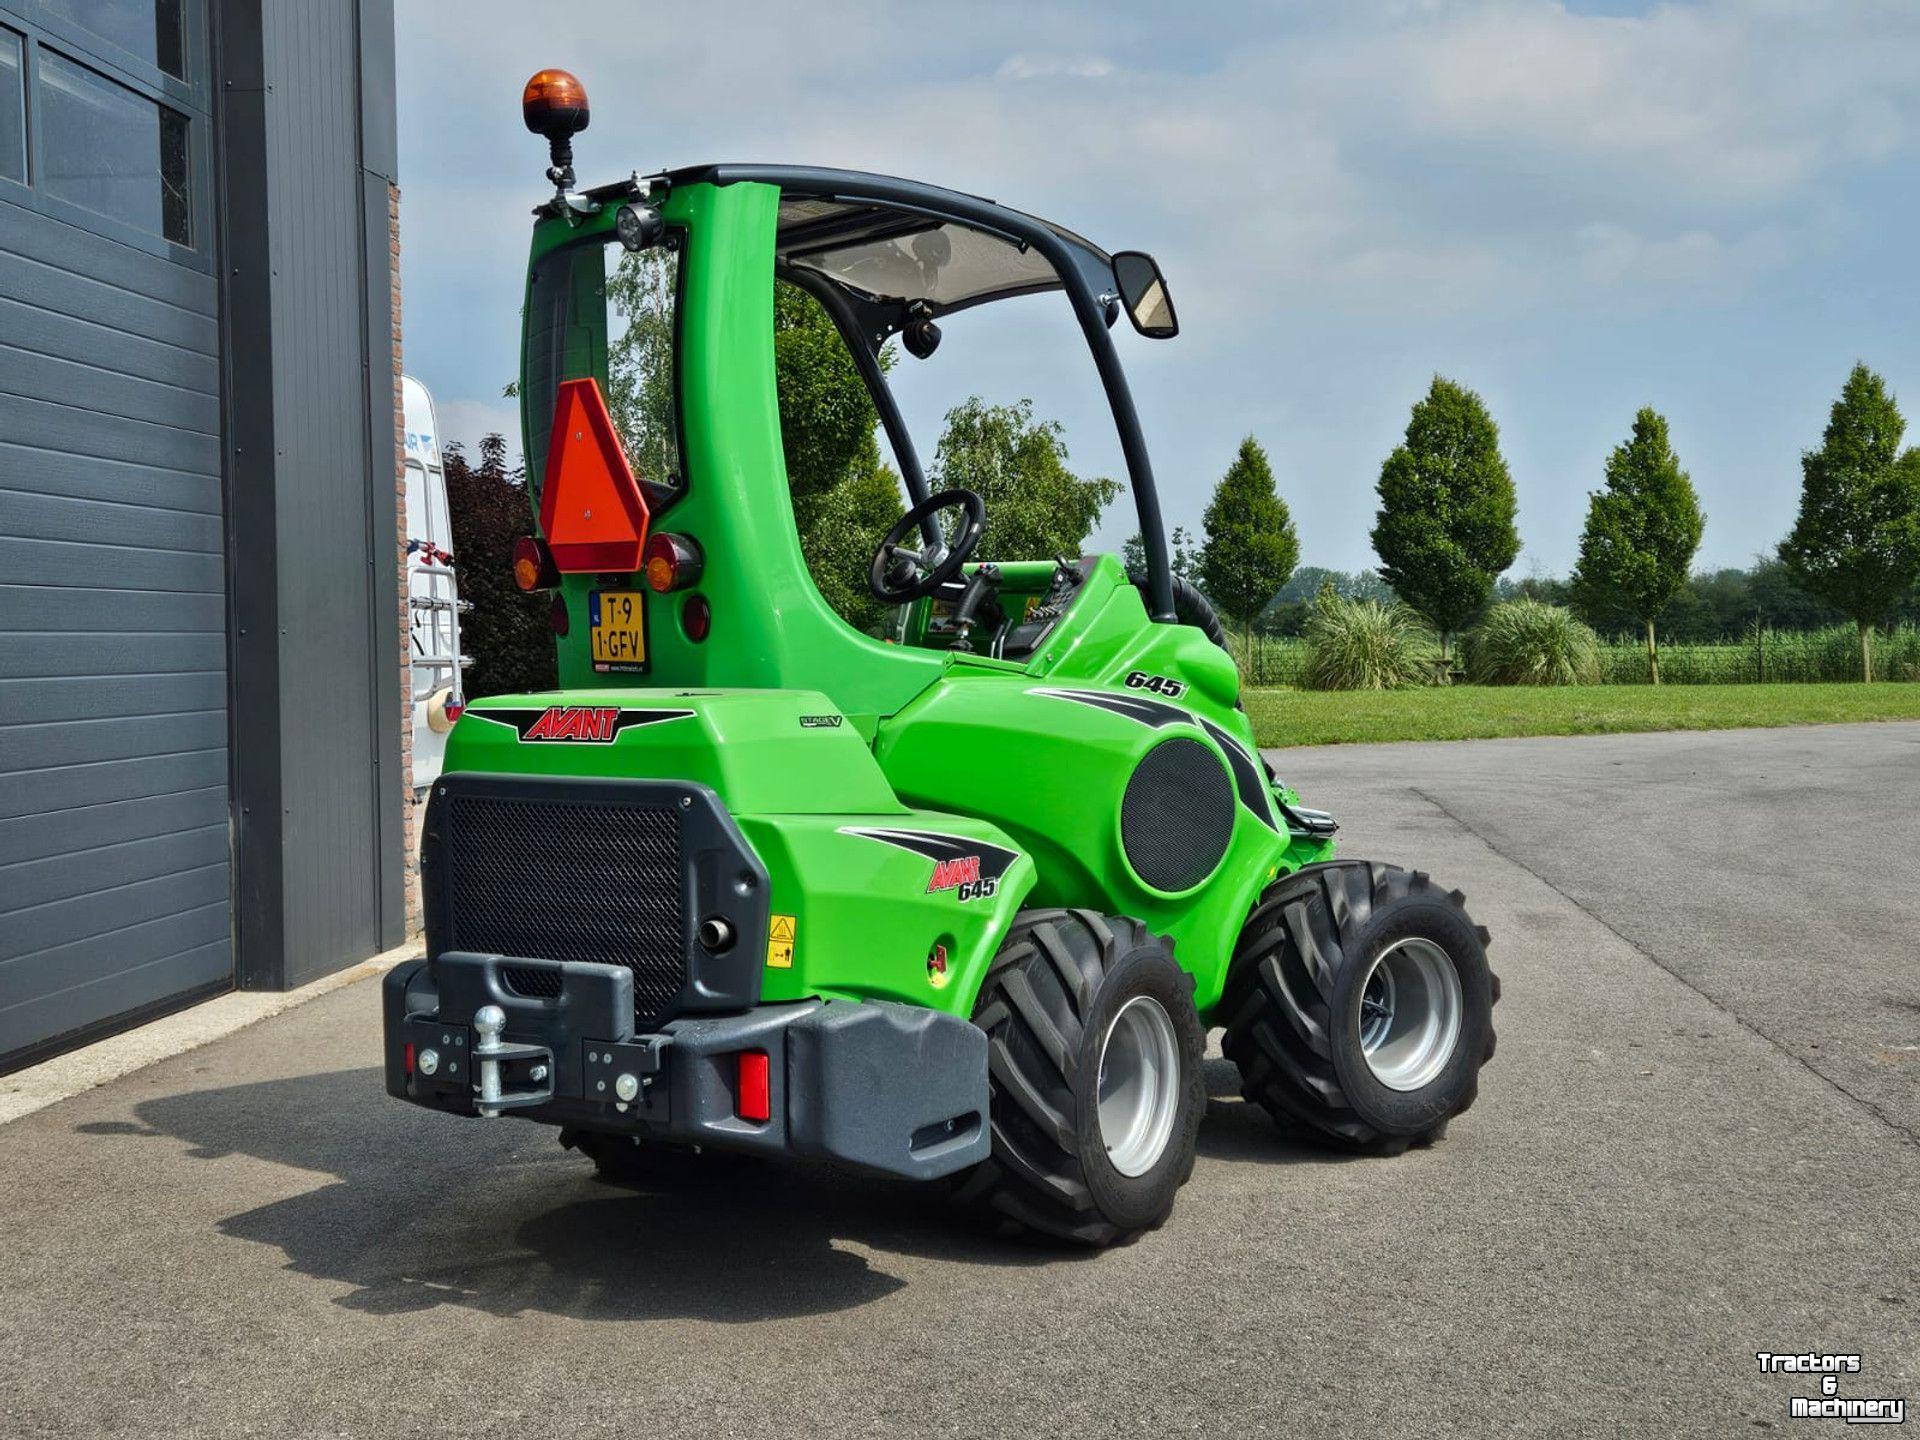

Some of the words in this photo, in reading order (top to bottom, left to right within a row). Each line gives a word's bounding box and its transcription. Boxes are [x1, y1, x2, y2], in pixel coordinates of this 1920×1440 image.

[608, 597, 632, 624] T-9
[597, 631, 639, 657] 1-GFV
[523, 706, 622, 740] AVANT
[926, 856, 981, 893] AVANT
